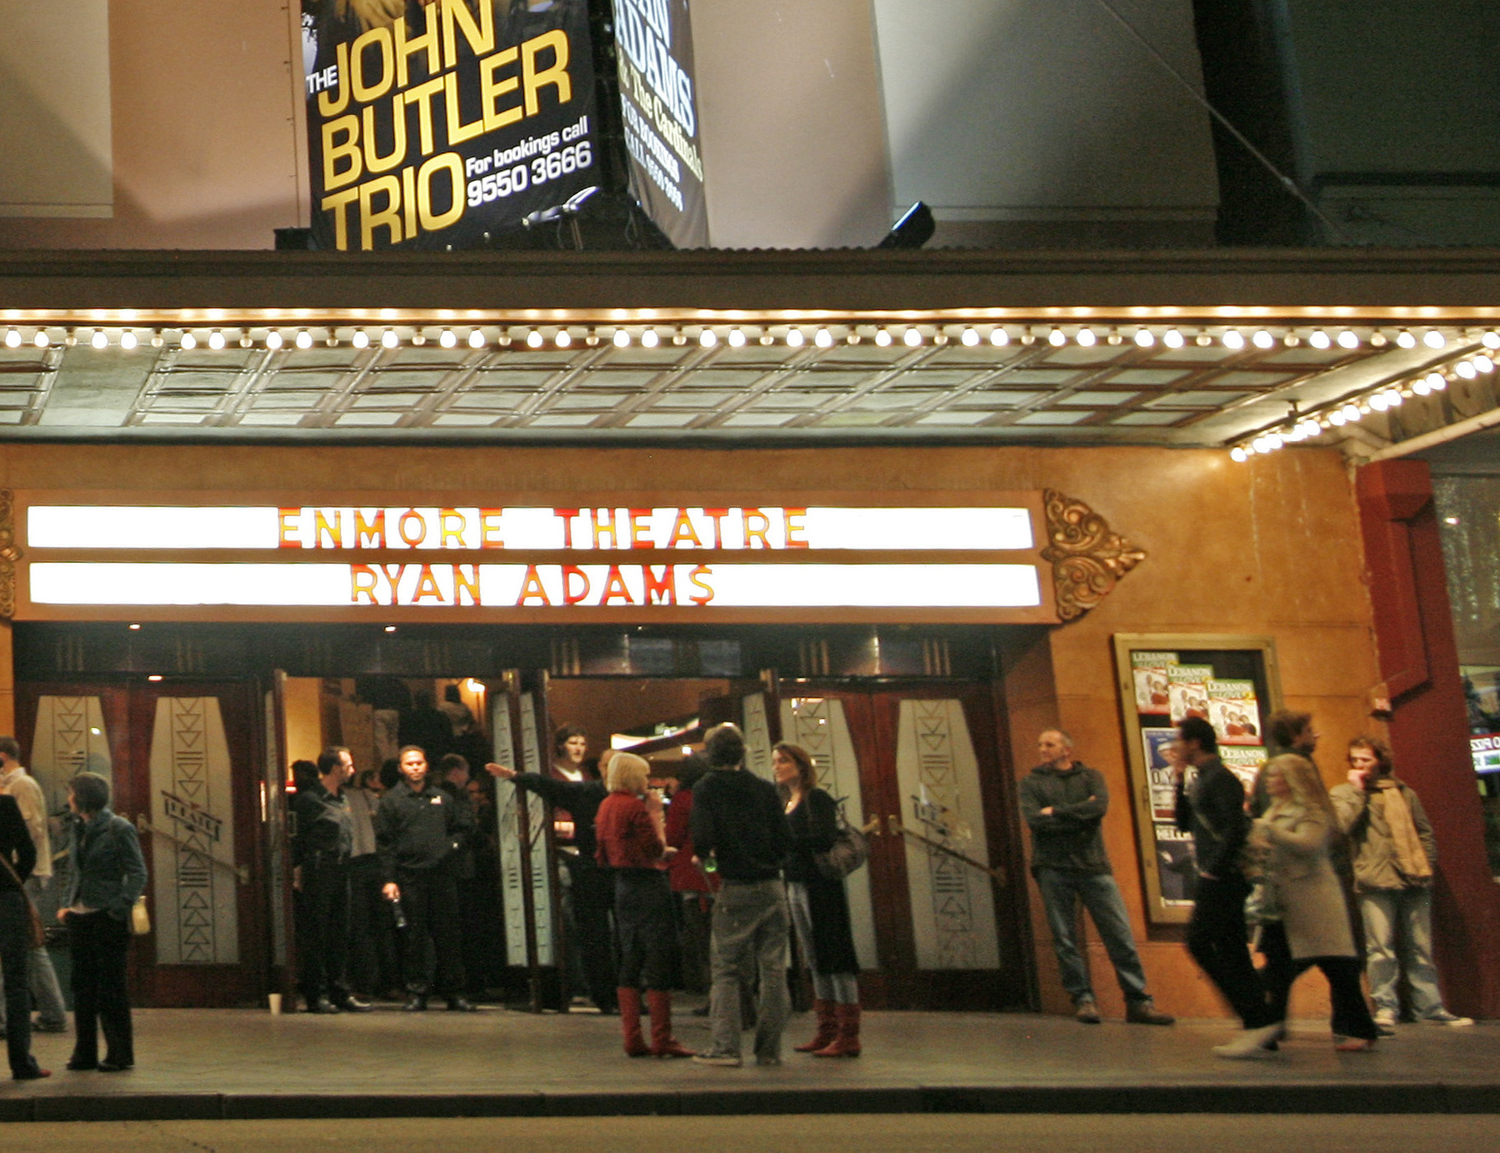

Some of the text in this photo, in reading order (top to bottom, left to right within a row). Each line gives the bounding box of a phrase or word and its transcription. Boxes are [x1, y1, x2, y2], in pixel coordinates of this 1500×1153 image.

[306, 65, 338, 94] THE
[321, 29, 572, 192] BUTLER
[466, 115, 589, 178] For bookings call
[466, 141, 592, 207] 9550 3666
[321, 151, 466, 251] TRIO
[277, 507, 809, 549] ENMORE THEATRE
[350, 564, 715, 606] RYAN ADAMS
